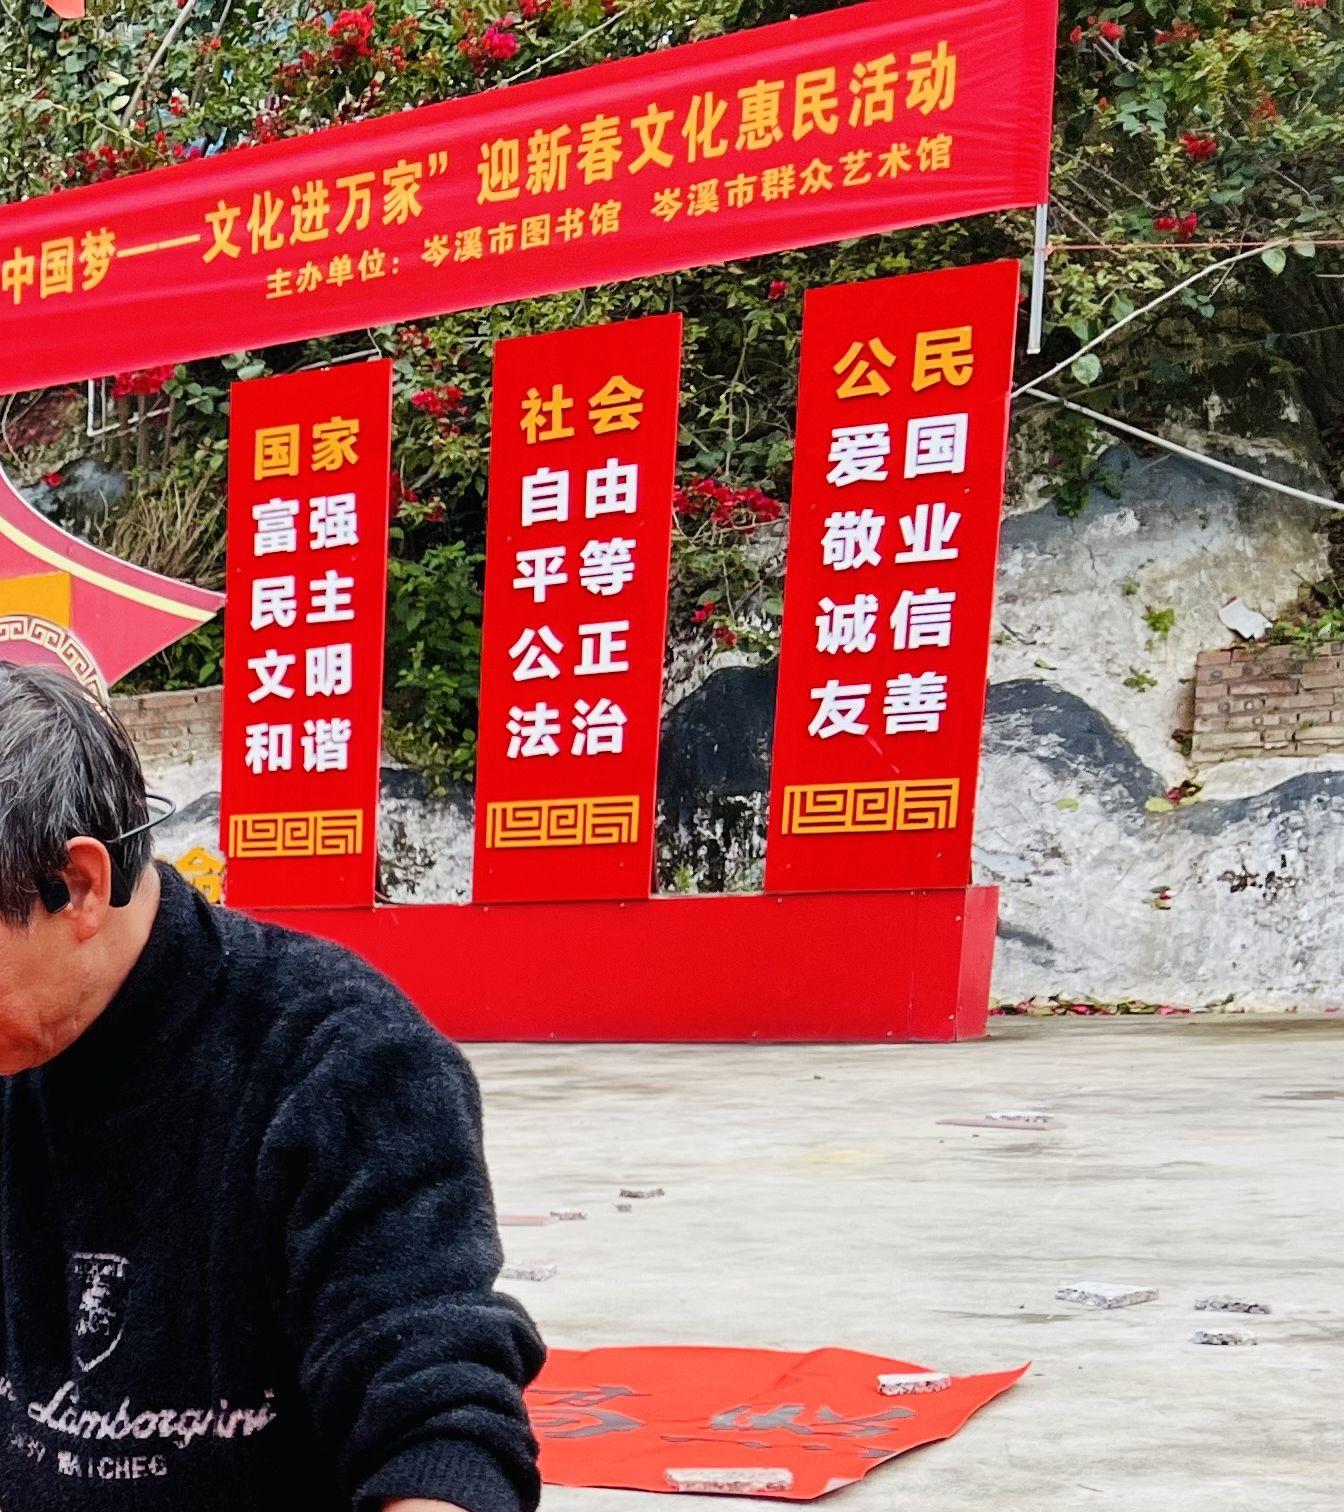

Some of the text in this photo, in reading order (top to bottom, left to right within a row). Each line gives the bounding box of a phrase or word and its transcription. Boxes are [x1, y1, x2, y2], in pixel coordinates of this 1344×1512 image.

[650, 132, 953, 224] 岑溪市群众艺术馆
[833, 325, 974, 400] 公民
[520, 375, 645, 445] 社会
[254, 416, 360, 481] 国家
[826, 412, 969, 488] 爱国
[252, 492, 359, 557] 富强
[521, 457, 639, 527] 自由
[513, 537, 637, 603] 平等
[821, 502, 962, 572] 敬业
[250, 569, 355, 631] 民主
[815, 587, 957, 656] 诚信
[248, 642, 353, 704] 文明
[509, 619, 630, 682] 公正
[506, 697, 628, 759] 法治
[808, 671, 948, 740] 友善
[245, 717, 352, 775] 和谐
